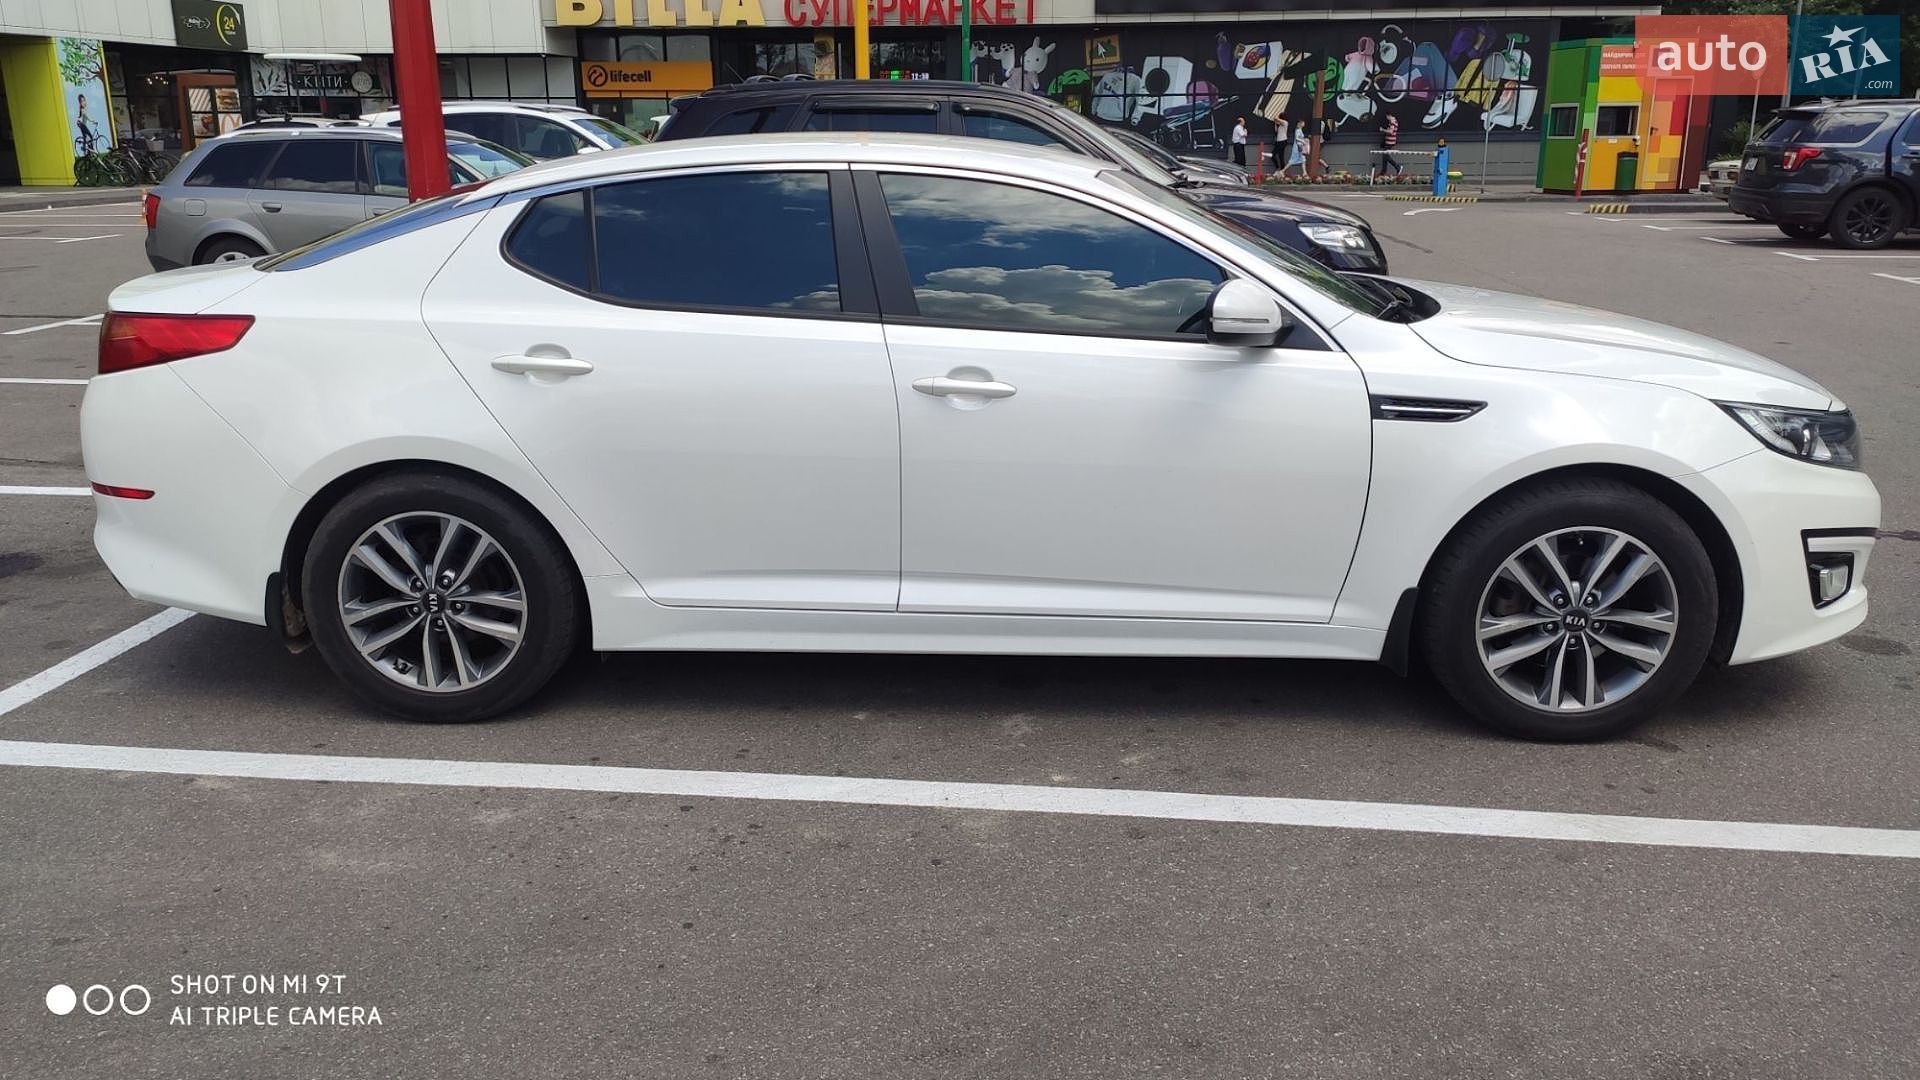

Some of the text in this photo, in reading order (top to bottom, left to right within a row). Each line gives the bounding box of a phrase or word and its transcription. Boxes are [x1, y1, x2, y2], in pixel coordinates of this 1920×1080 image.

[784, 0, 1034, 25] СУПРМАРКЕТ
[224, 16, 235, 30] 24
[609, 70, 652, 82] lifecell
[429, 594, 438, 612] KIA
[1566, 615, 1585, 627] KIA
